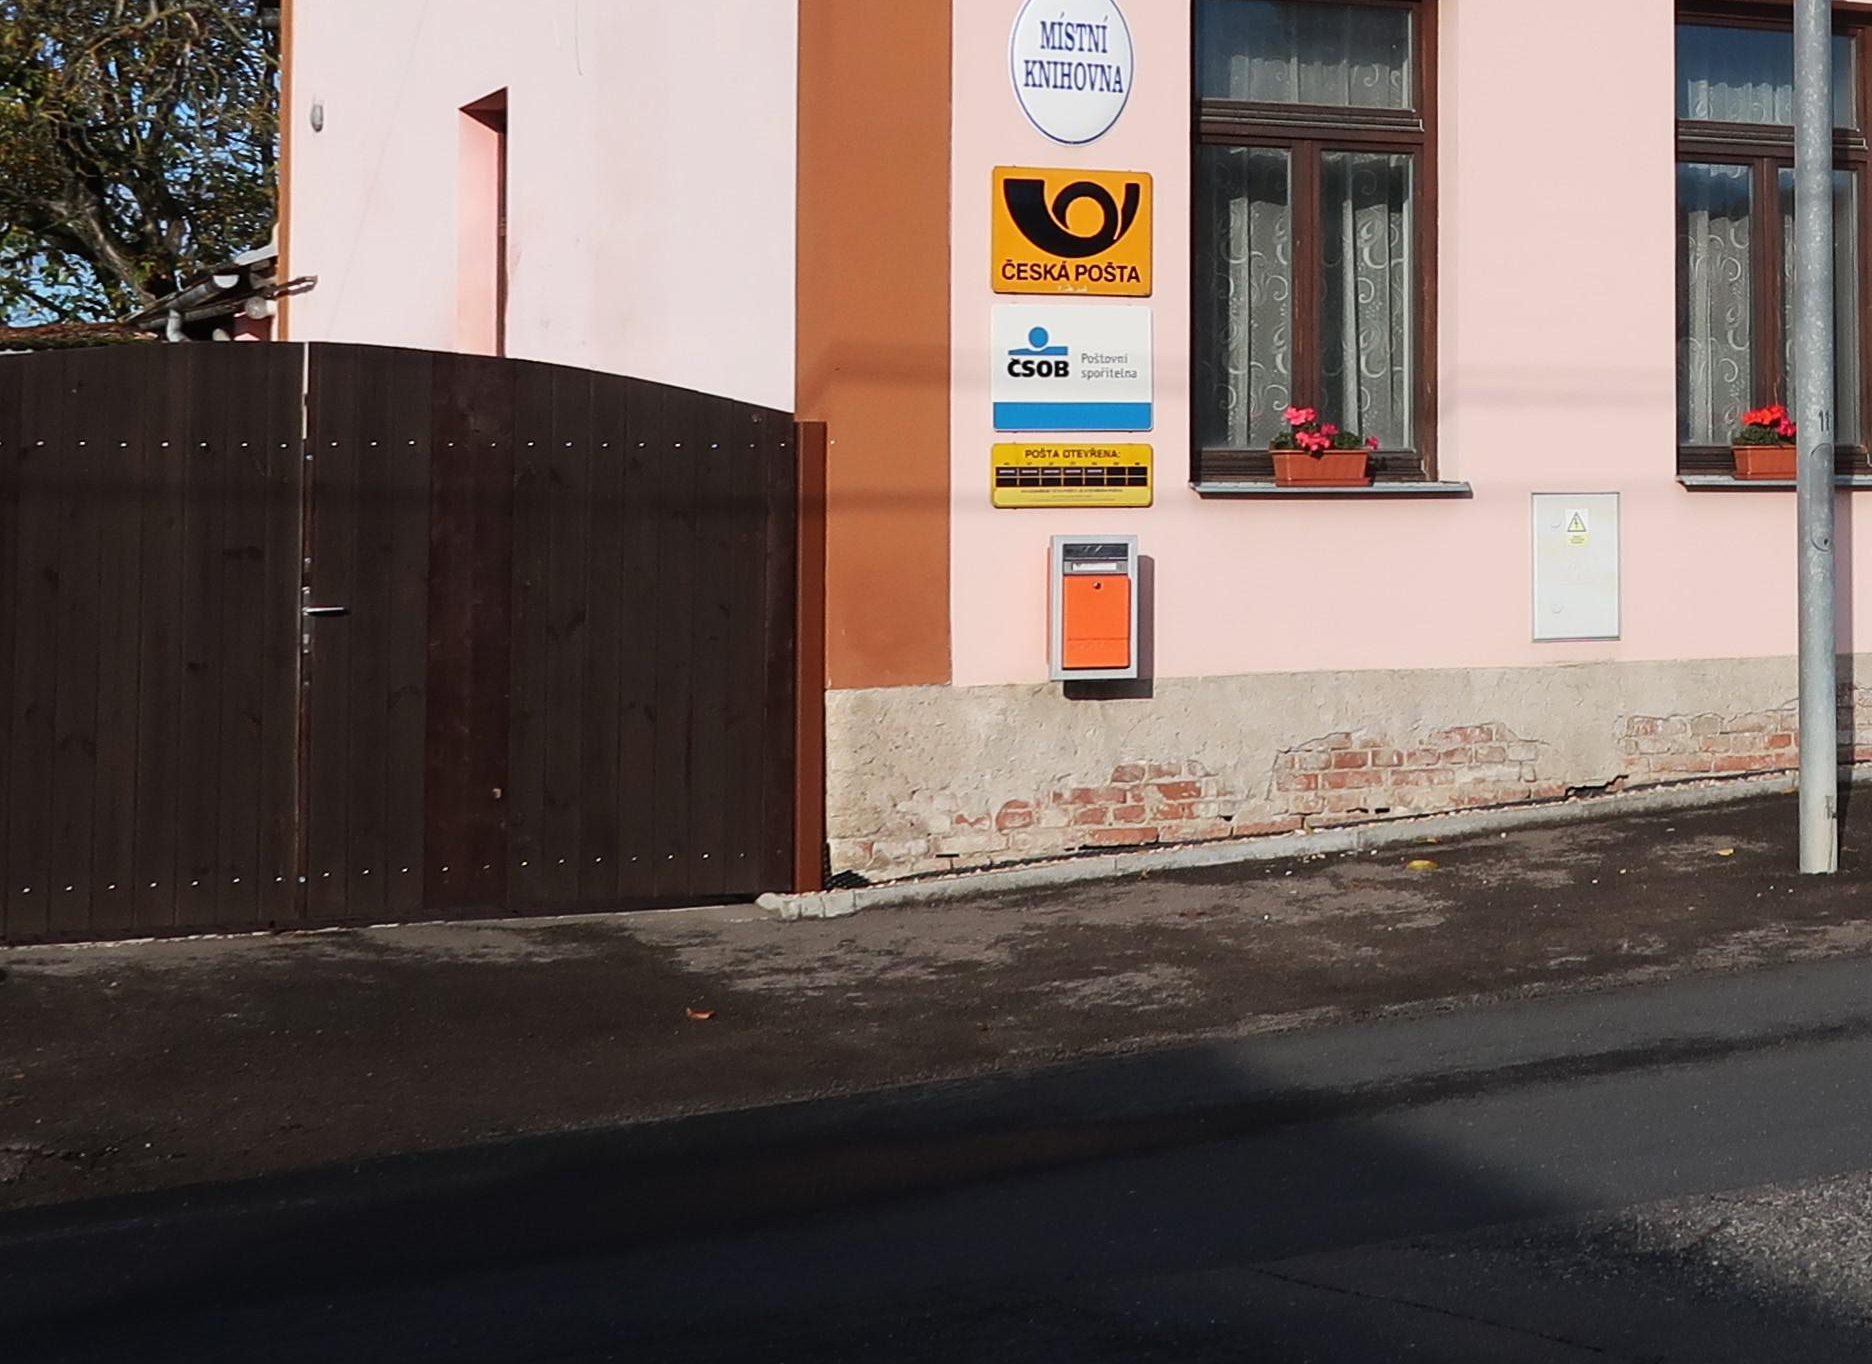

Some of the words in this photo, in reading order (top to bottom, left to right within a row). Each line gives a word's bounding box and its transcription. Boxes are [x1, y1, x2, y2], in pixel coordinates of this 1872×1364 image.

[1040, 12, 1108, 53] MÍSTNÍ
[1023, 59, 1124, 93] KNIHOVNA
[1001, 259, 1070, 281] ČESKÁ
[1075, 262, 1141, 283] POŠTA
[1007, 357, 1070, 378] ČSOB
[1081, 352, 1128, 364] Poštovní
[1081, 367, 1138, 380] spořitelna
[1025, 447, 1060, 459] POŠTA
[1063, 447, 1121, 459] OTEVŘENA:
